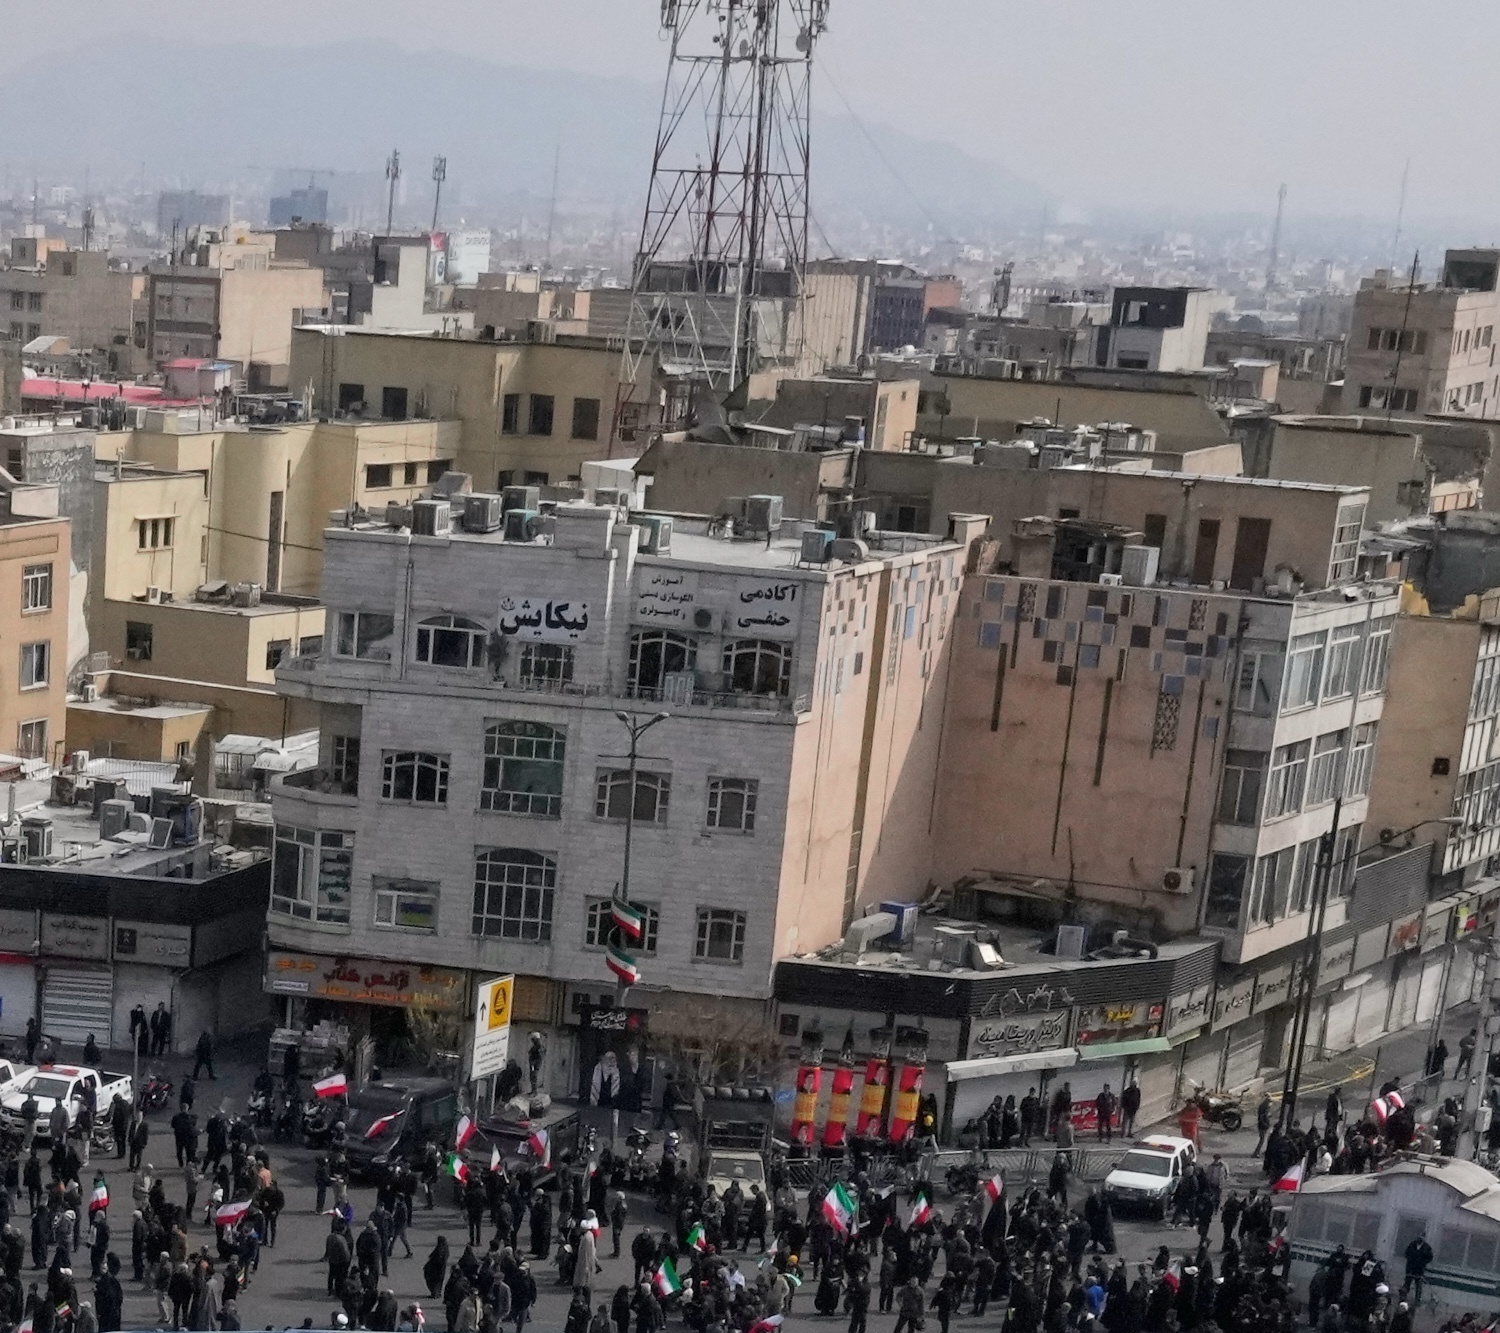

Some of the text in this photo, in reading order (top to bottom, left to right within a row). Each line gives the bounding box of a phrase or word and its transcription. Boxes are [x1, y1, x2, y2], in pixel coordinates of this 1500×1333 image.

[740, 584, 799, 602] آکادمی
[500, 599, 589, 638] نیکایش
[737, 610, 791, 629] حنفی
[1037, 1011, 1065, 1042] دکتر
